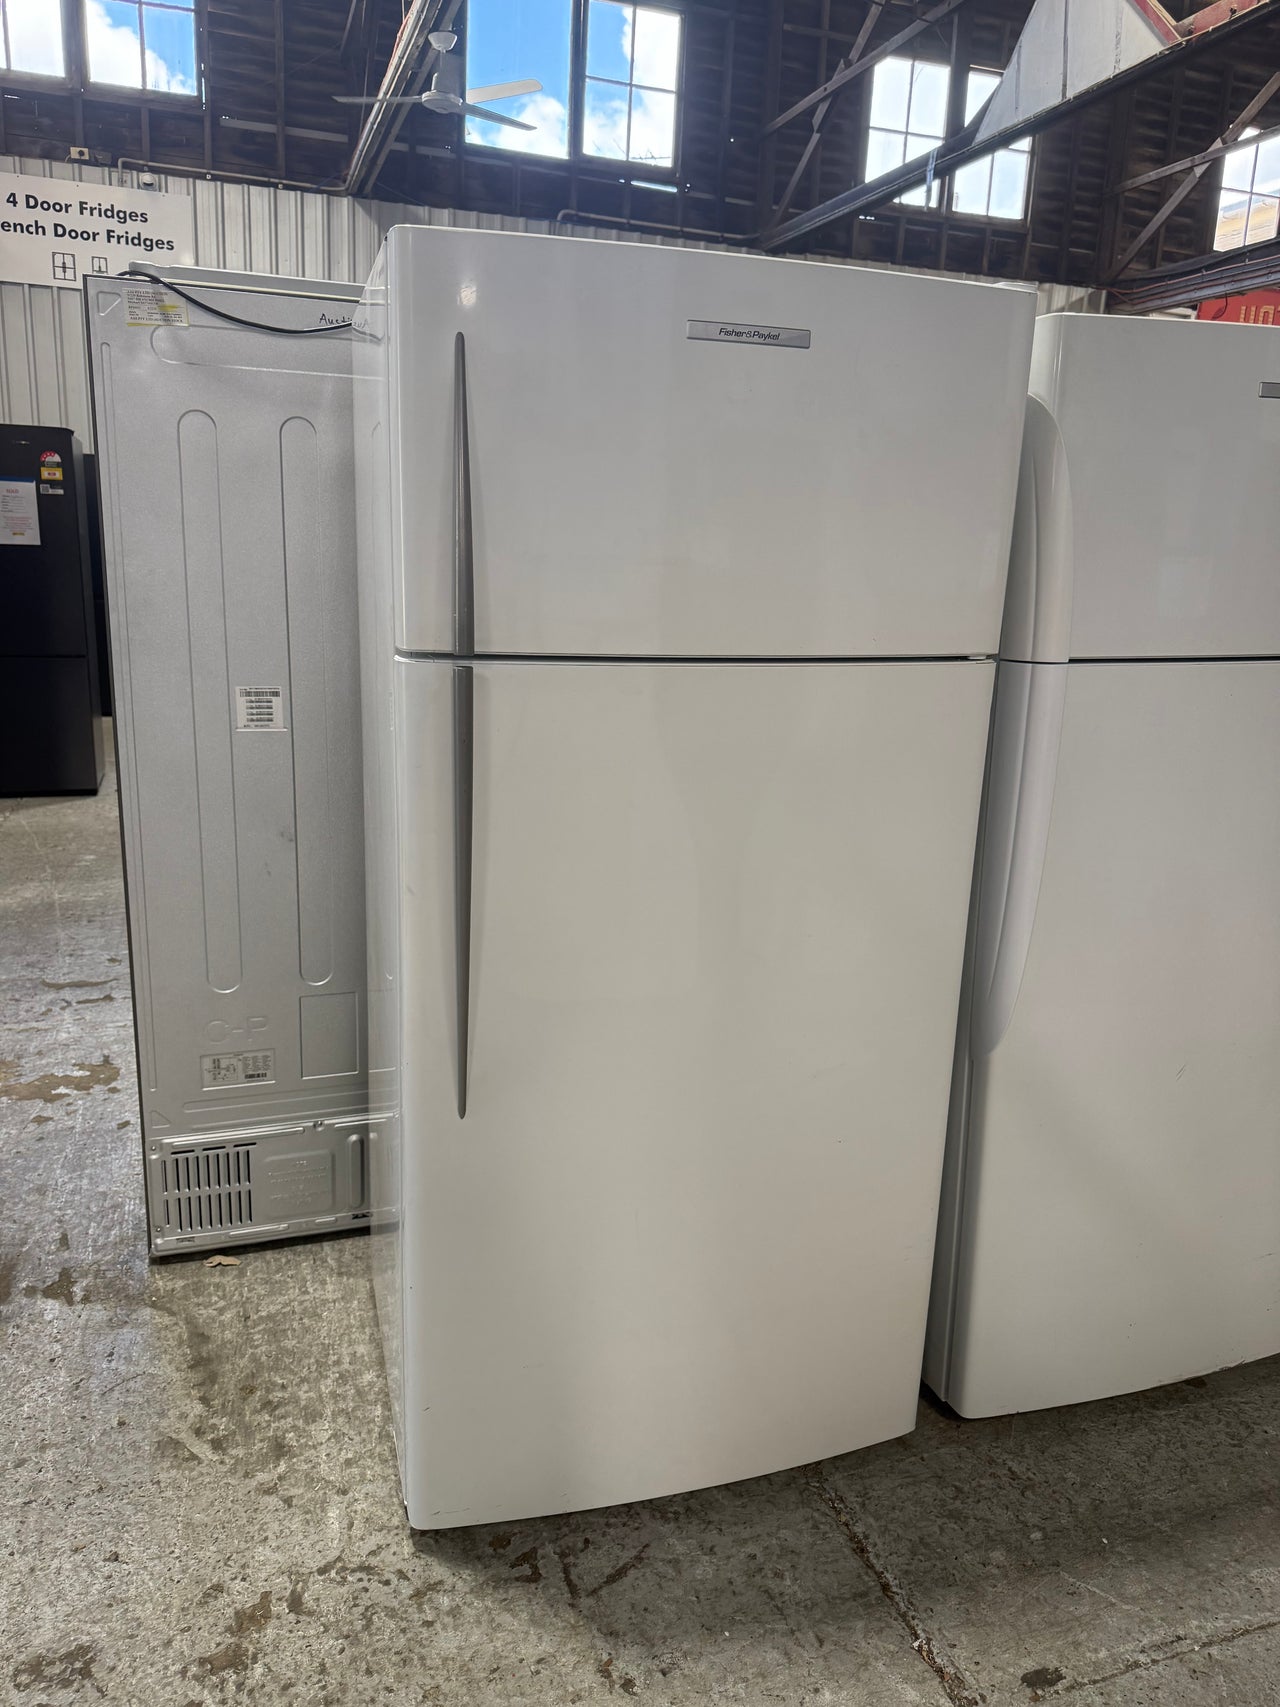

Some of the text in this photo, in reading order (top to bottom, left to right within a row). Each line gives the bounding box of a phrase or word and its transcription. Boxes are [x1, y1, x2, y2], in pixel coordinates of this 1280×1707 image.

[6, 192, 149, 224] 4 Door Fridges
[0, 220, 175, 252] ench Door Fridges
[718, 327, 781, 342] Fisher&Paykel
